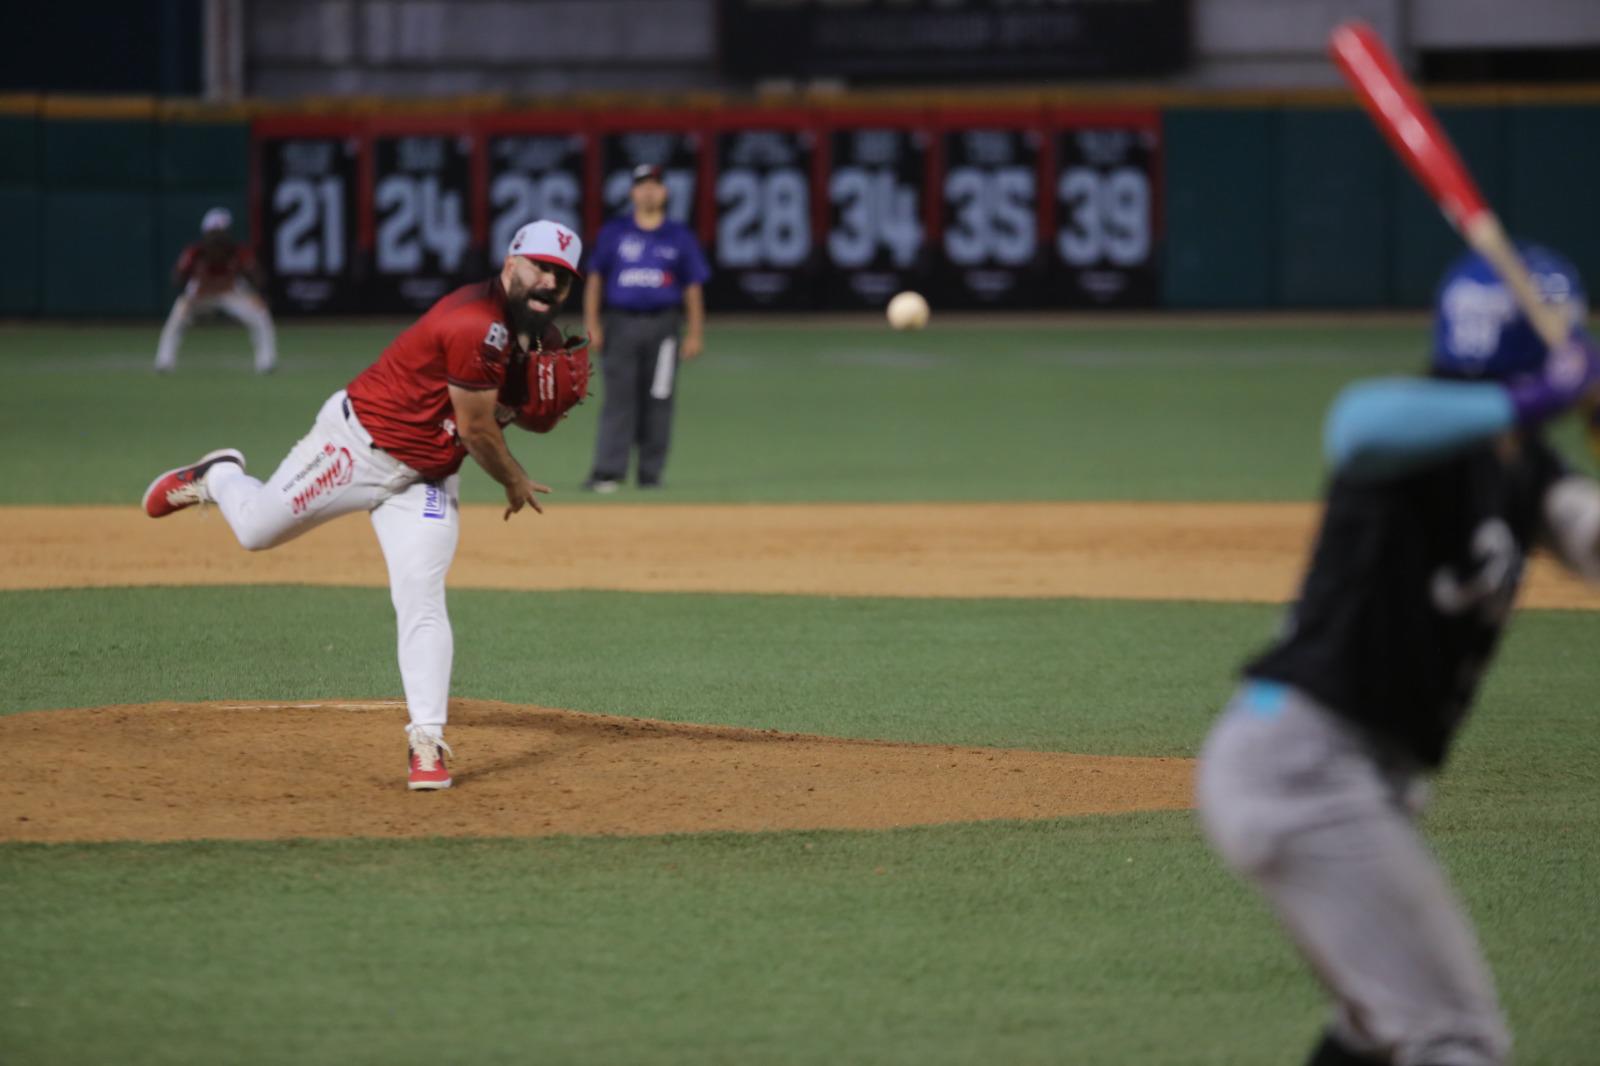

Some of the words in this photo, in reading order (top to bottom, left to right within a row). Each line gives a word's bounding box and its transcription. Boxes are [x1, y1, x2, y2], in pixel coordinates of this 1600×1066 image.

[273, 175, 347, 276] 21
[375, 172, 470, 275] 24
[715, 167, 811, 267] 28
[829, 167, 924, 267] 34
[944, 167, 1037, 267] 35
[1058, 167, 1152, 267] 39
